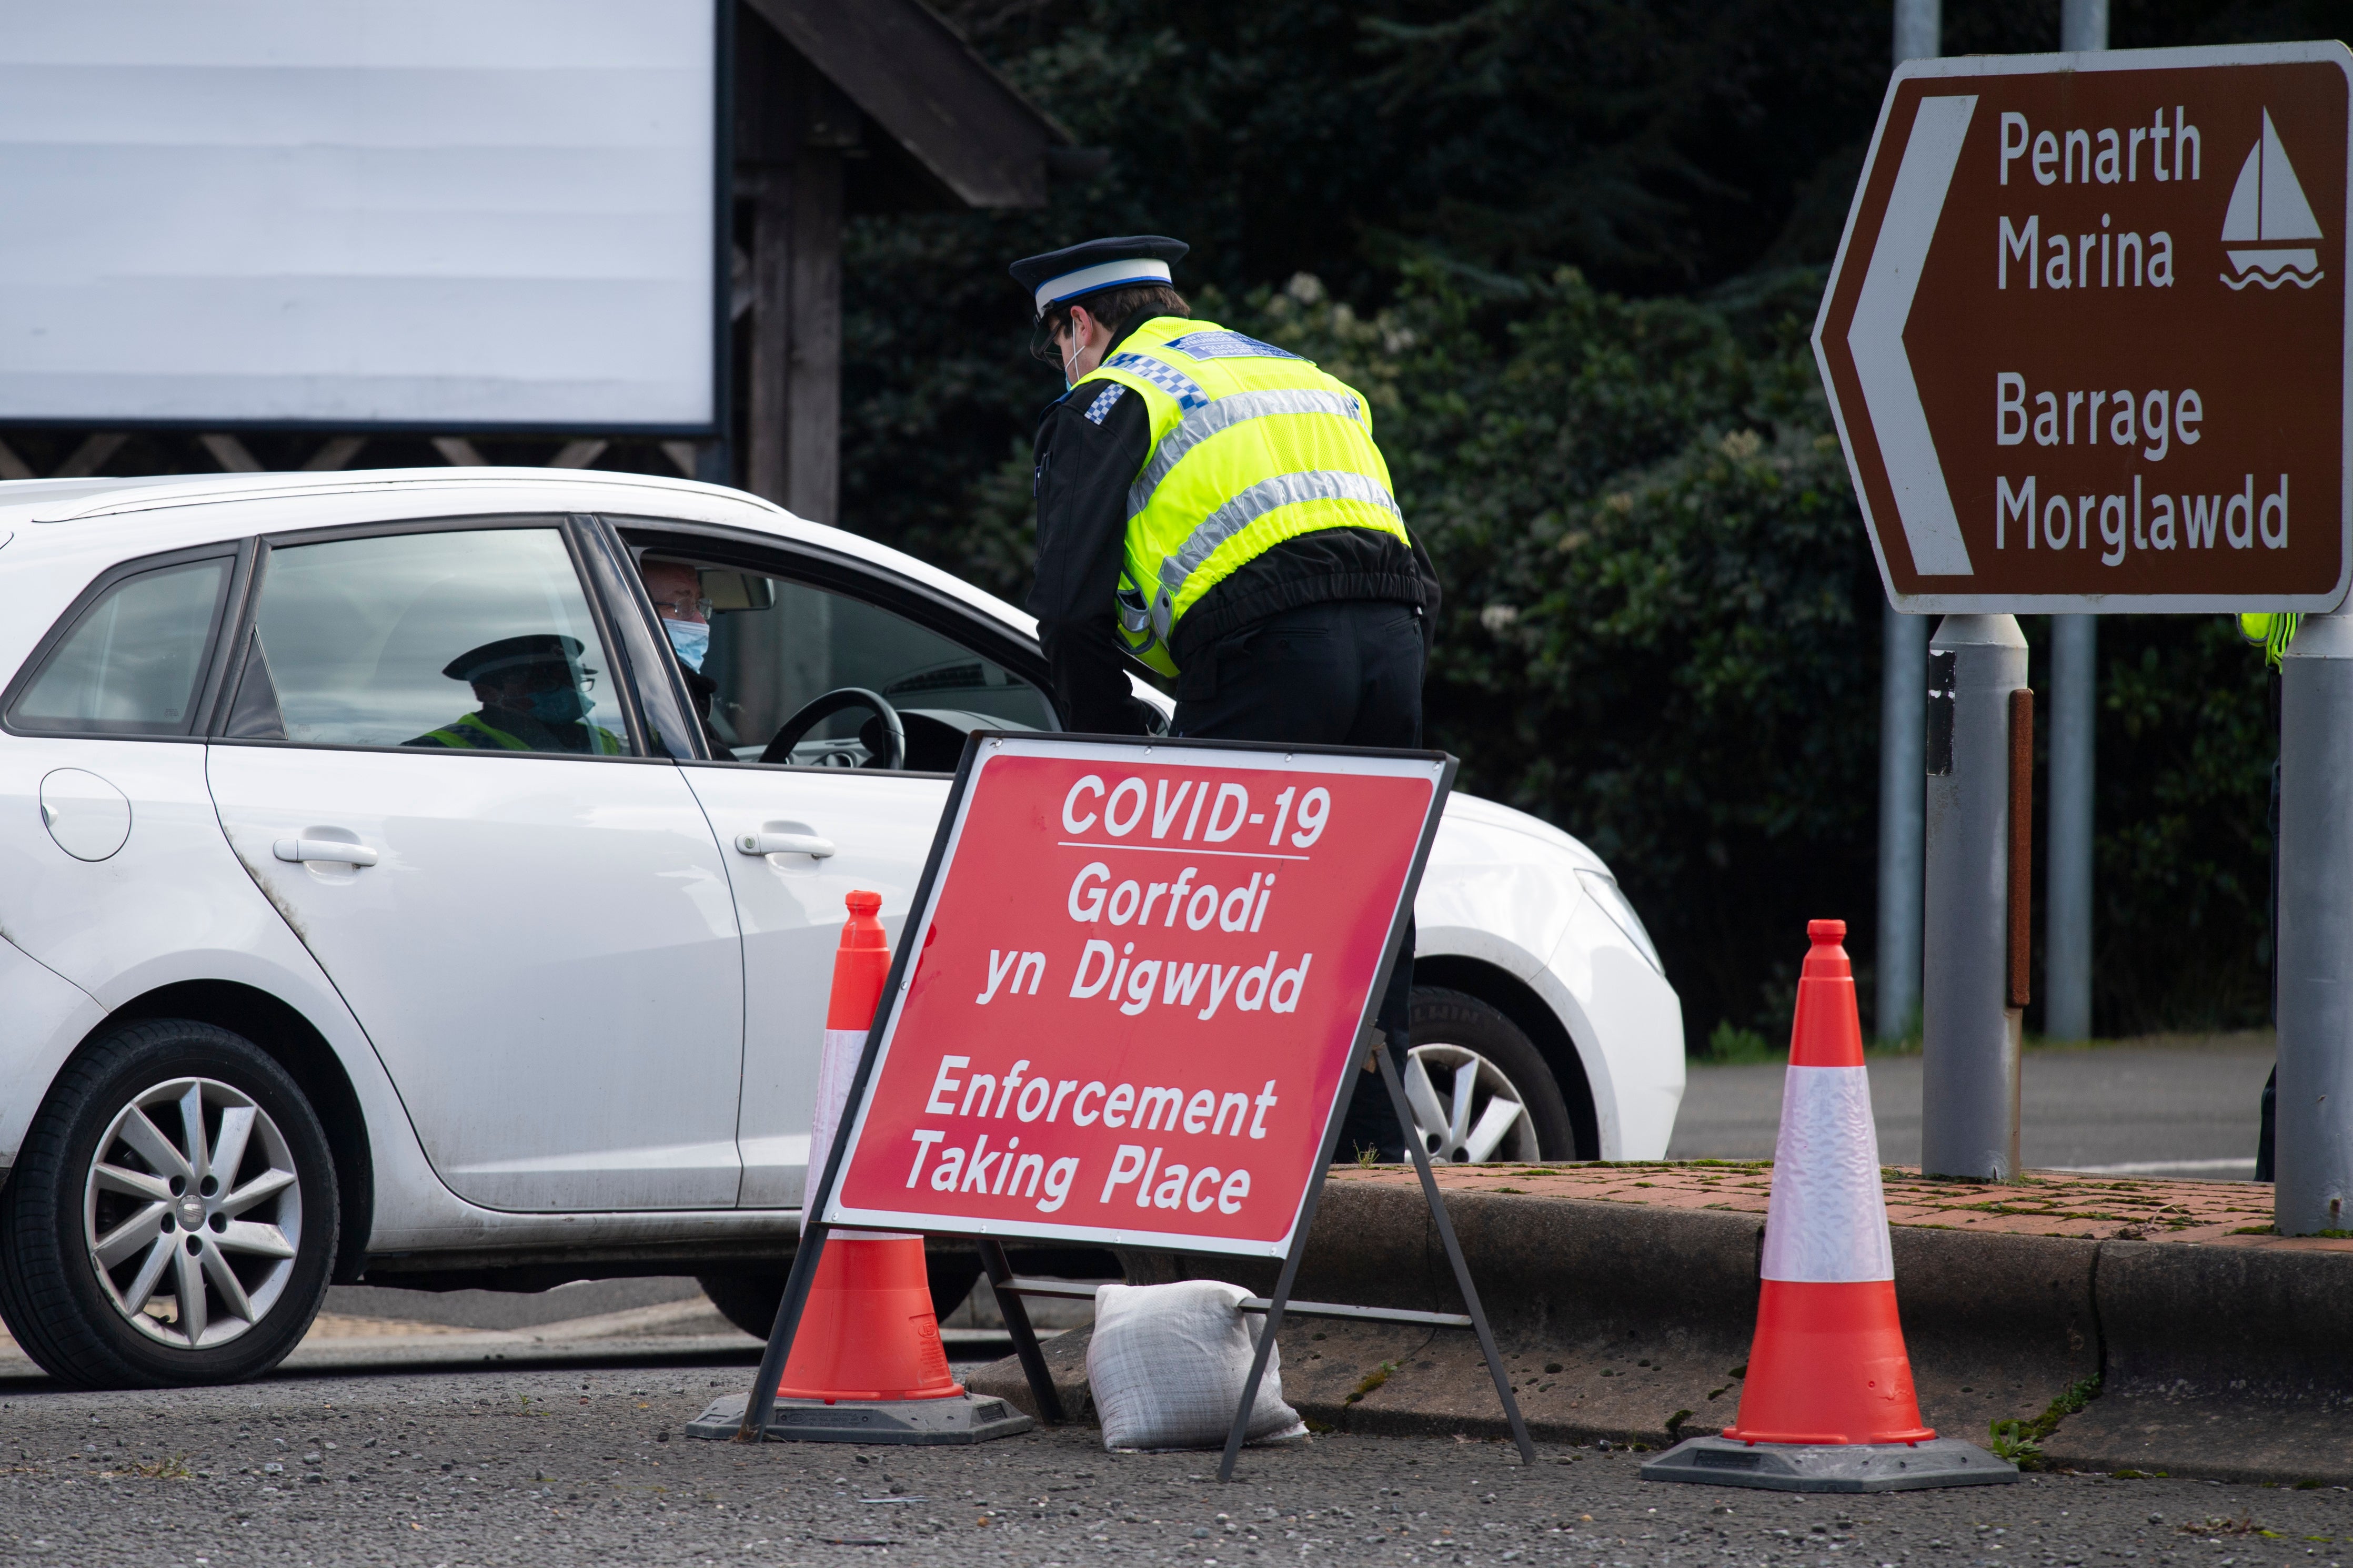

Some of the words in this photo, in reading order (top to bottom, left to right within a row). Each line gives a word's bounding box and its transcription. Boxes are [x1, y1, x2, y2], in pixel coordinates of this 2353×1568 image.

[2000, 106, 2200, 186] Penarth
[1998, 213, 2174, 289] Marina
[1997, 372, 2203, 461] Barrage
[1996, 474, 2288, 566] Morglawdd
[1062, 775, 1331, 848] COVID-19
[1068, 862, 1275, 933] Gorfodi
[976, 949, 1046, 1005] yn
[1069, 939, 1313, 1020] Digwydd
[924, 1055, 1278, 1139] Enforcement
[906, 1129, 1080, 1213] Taking
[1099, 1144, 1251, 1215] Place
